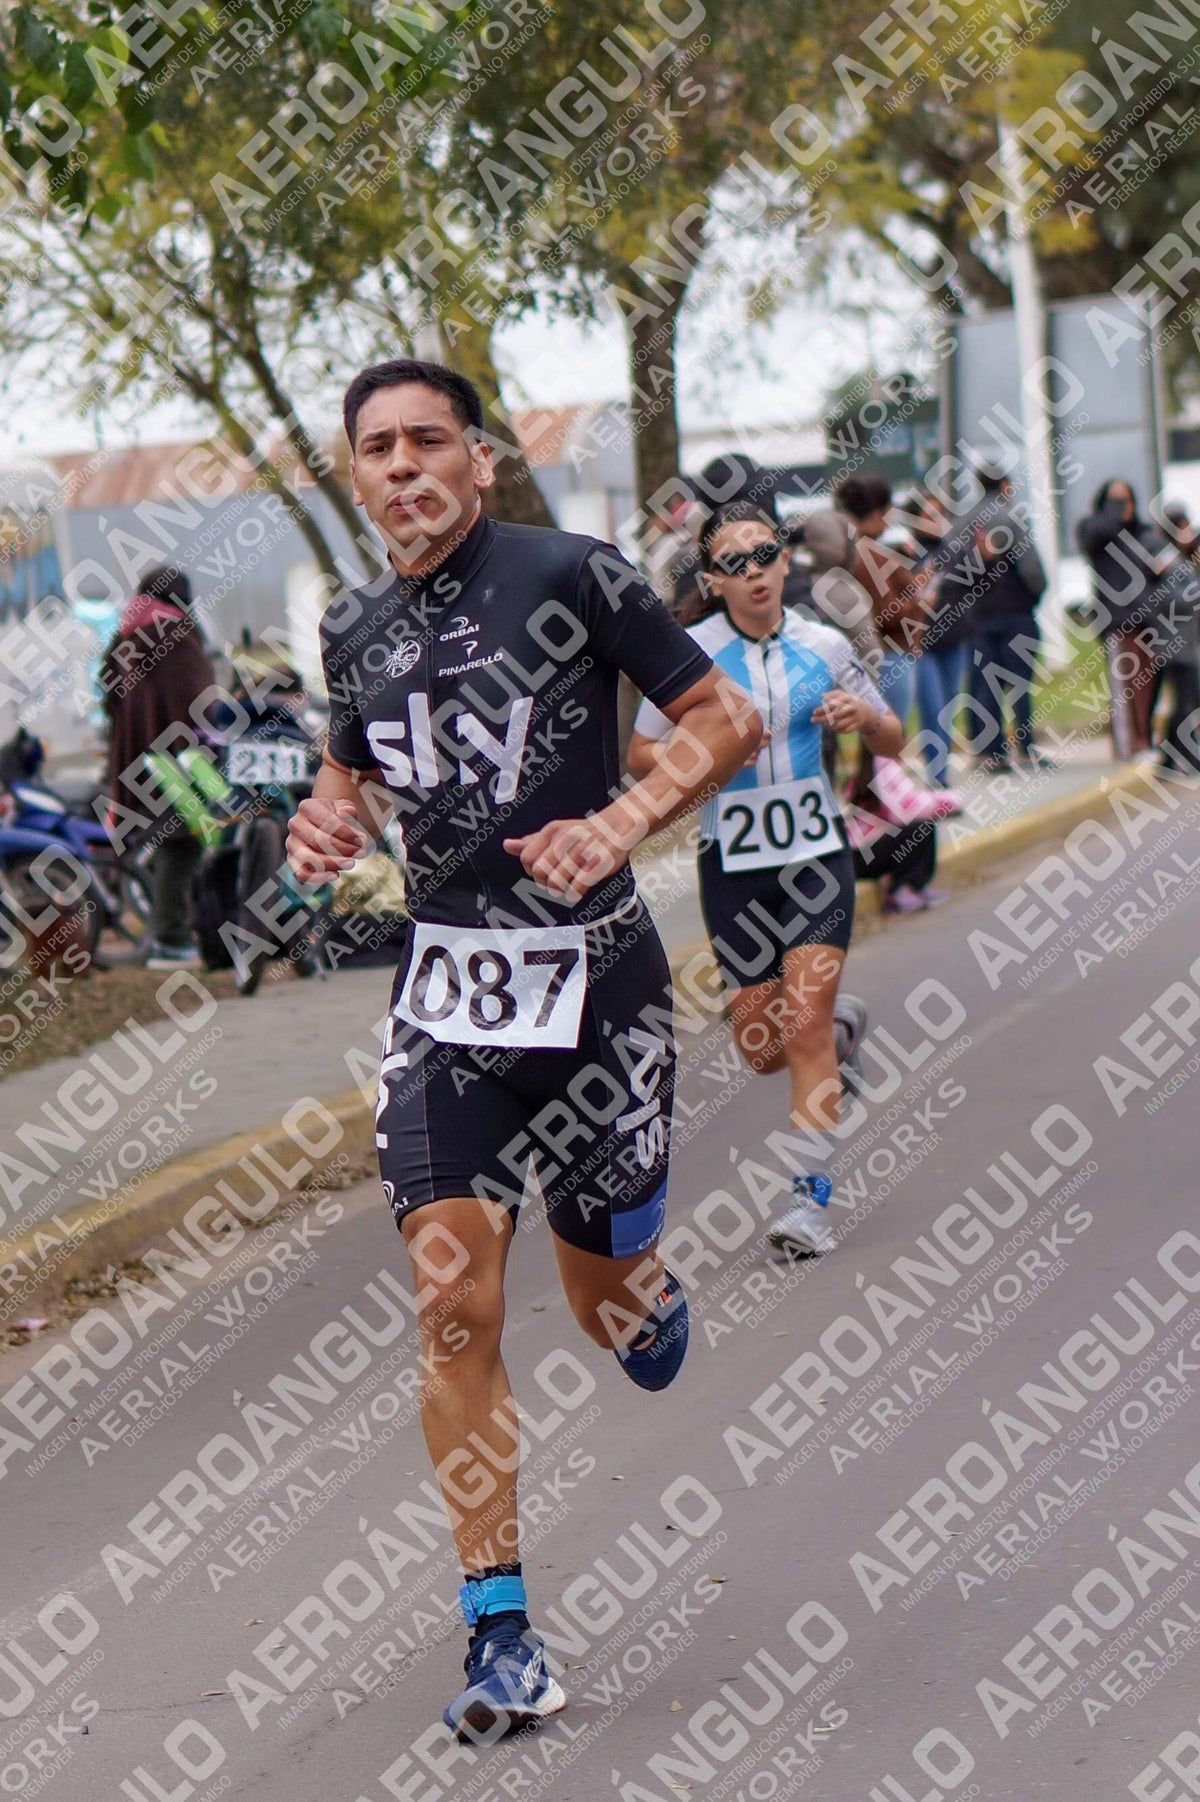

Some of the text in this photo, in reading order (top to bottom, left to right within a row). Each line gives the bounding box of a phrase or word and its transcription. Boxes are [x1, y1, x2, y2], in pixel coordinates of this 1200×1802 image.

[439, 624, 480, 641] ORBAI
[438, 652, 503, 677] PINARELLO
[722, 790, 829, 857] 203
[408, 945, 580, 1031] 087
